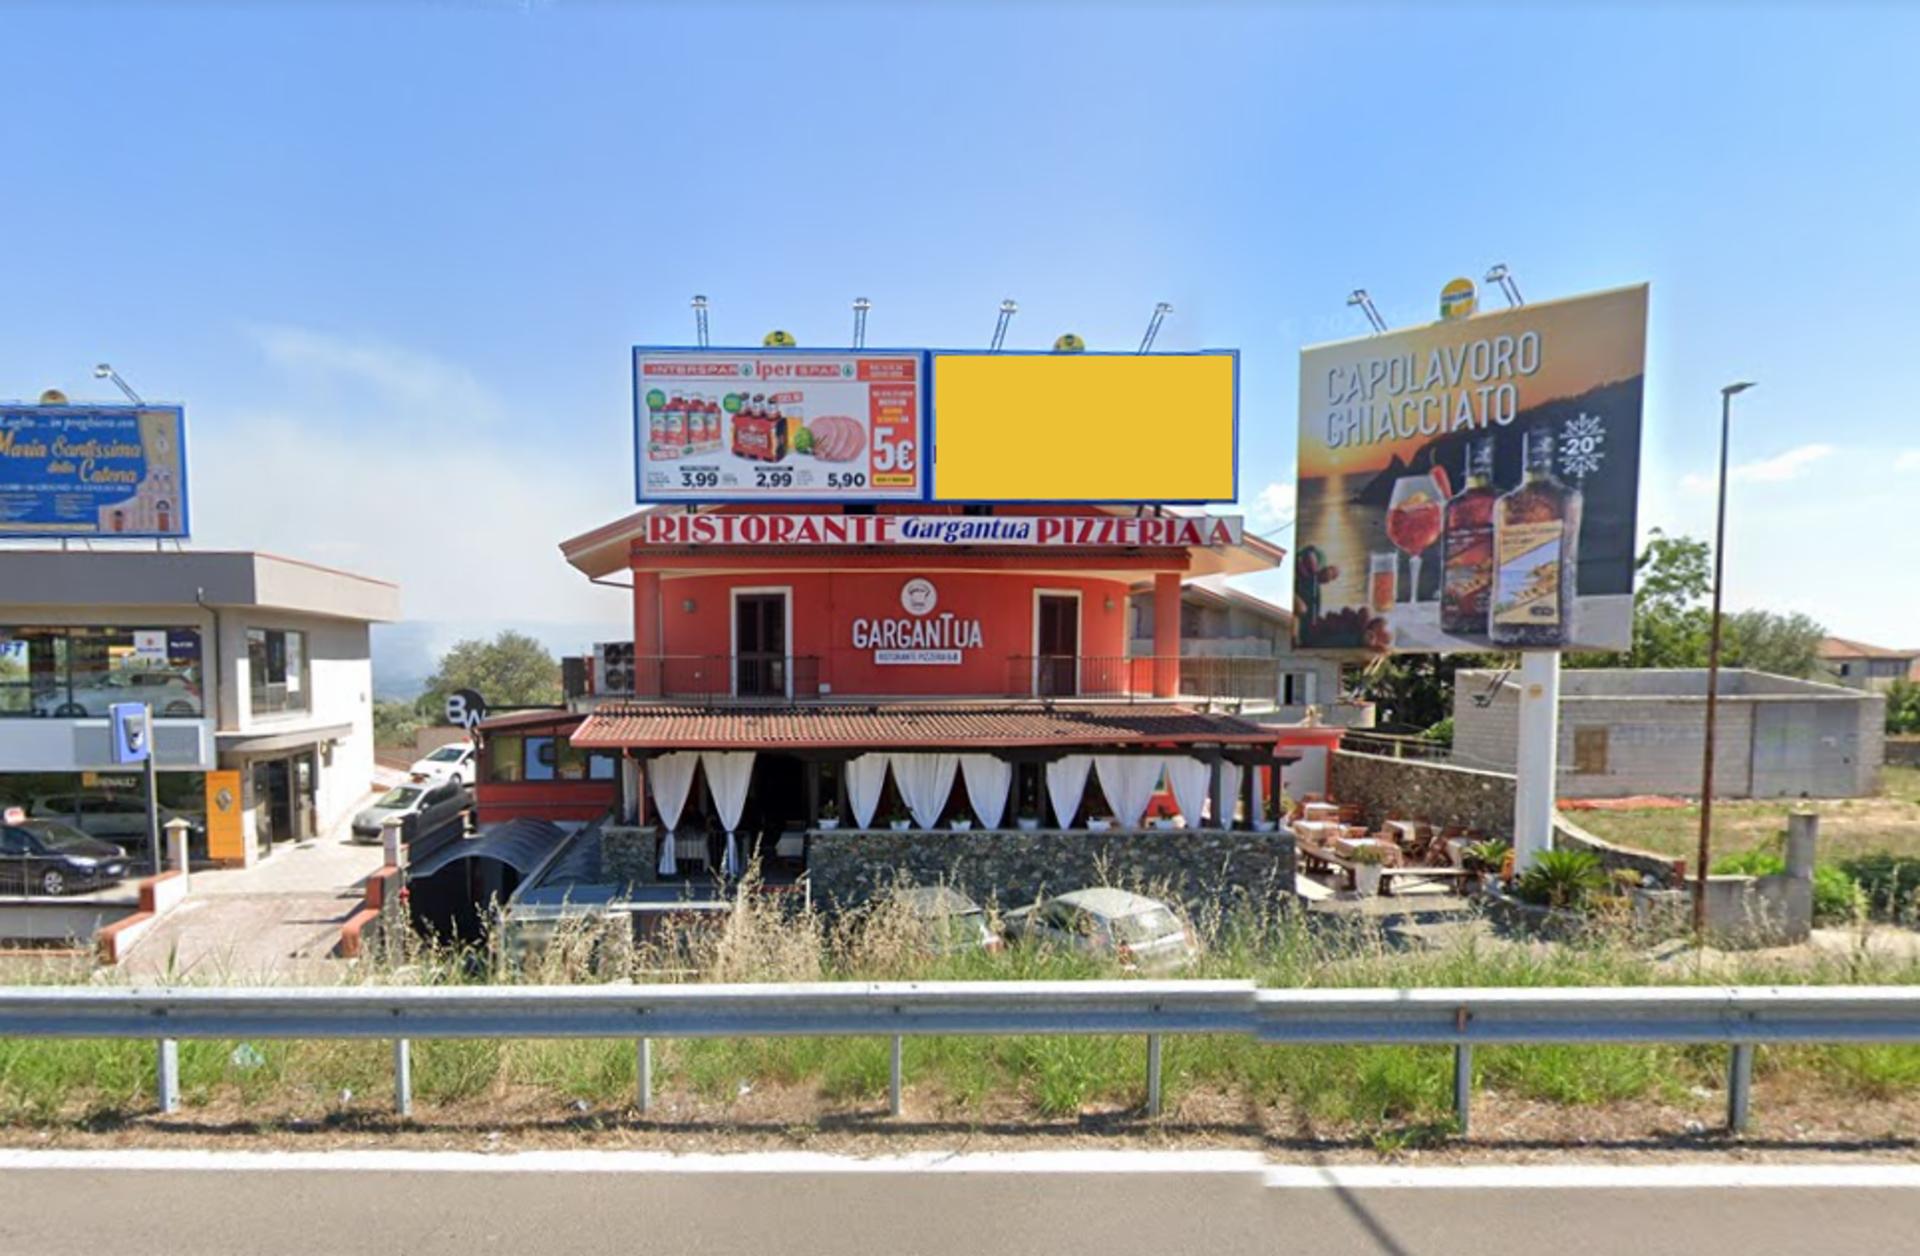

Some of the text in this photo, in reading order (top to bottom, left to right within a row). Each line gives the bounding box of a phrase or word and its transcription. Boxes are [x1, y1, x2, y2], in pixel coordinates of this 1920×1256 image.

[1328, 331, 1541, 406] CAPOLAVORO
[1326, 383, 1517, 449] GHIACCIATO
[51, 434, 141, 460] Santissima
[873, 427, 914, 471] 5€
[79, 458, 137, 483] Catena
[681, 472, 718, 487] 3,99
[756, 472, 792, 487] 2,99
[827, 472, 865, 488] 5,90
[650, 515, 896, 543] RISTORANTE
[900, 517, 1031, 543] Gargantua
[852, 613, 983, 649] GARGANTUA
